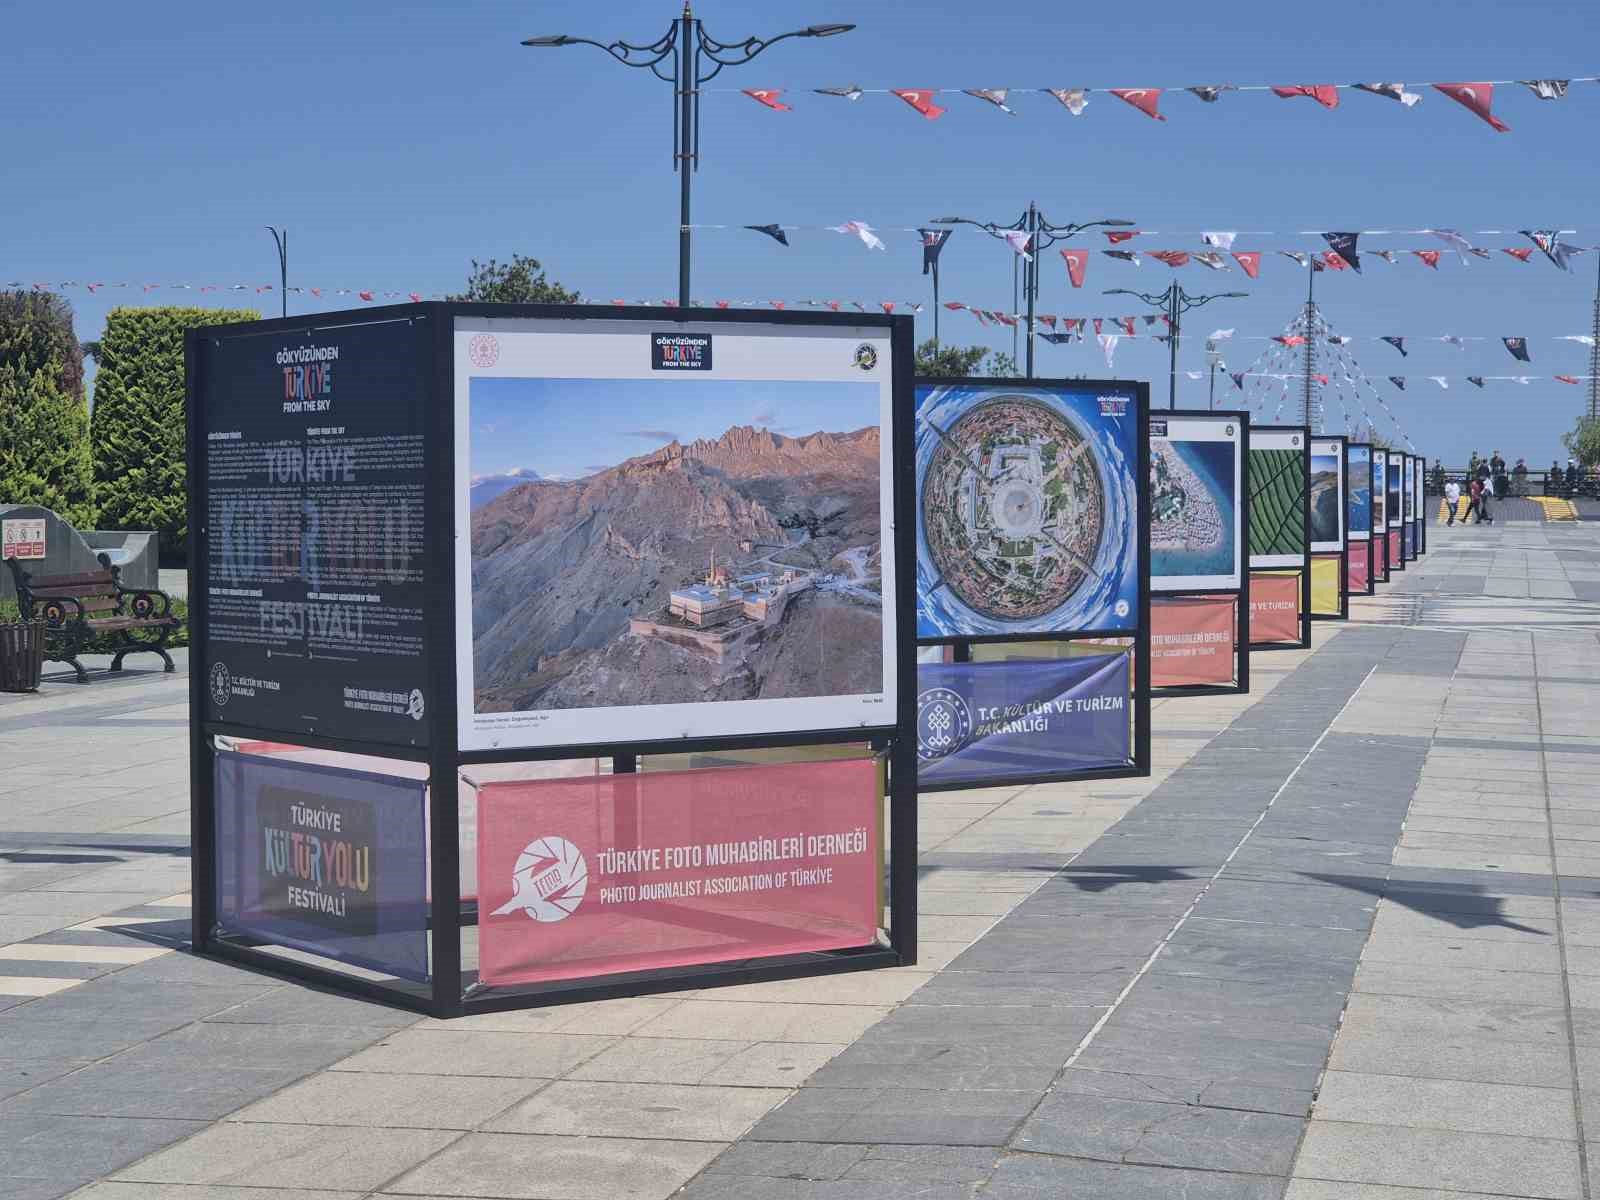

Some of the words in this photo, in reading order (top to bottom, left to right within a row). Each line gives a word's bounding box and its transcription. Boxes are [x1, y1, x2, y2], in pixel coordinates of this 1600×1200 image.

[276, 345, 339, 364] GÖKYÜZÜNDEN
[282, 361, 331, 401] TÜRKİYE
[283, 402, 302, 413] FROM
[303, 401, 316, 412] THE
[317, 399, 331, 411] SKY
[977, 707, 1000, 721] T.C.
[1003, 700, 1053, 718] KÜLTÜR
[1055, 699, 1073, 713] VE
[1075, 694, 1123, 712] TURİZM
[976, 716, 1048, 736] BAKANLIĞI
[290, 801, 341, 832] TÜRKİYE
[322, 839, 369, 892] YOLU
[597, 845, 661, 875] TÜRKİYE
[664, 846, 701, 869] FOTO
[706, 832, 804, 866] MUHABİRLERİ
[807, 825, 867, 857] DERNEĞİ
[600, 885, 636, 905] PHOTO
[639, 880, 702, 901] JOURNALIST
[704, 873, 773, 895] ASSOCIATION
[775, 872, 788, 889] OF
[790, 866, 832, 887] TÜRKİYE
[288, 886, 346, 917] FESTİVALİ
